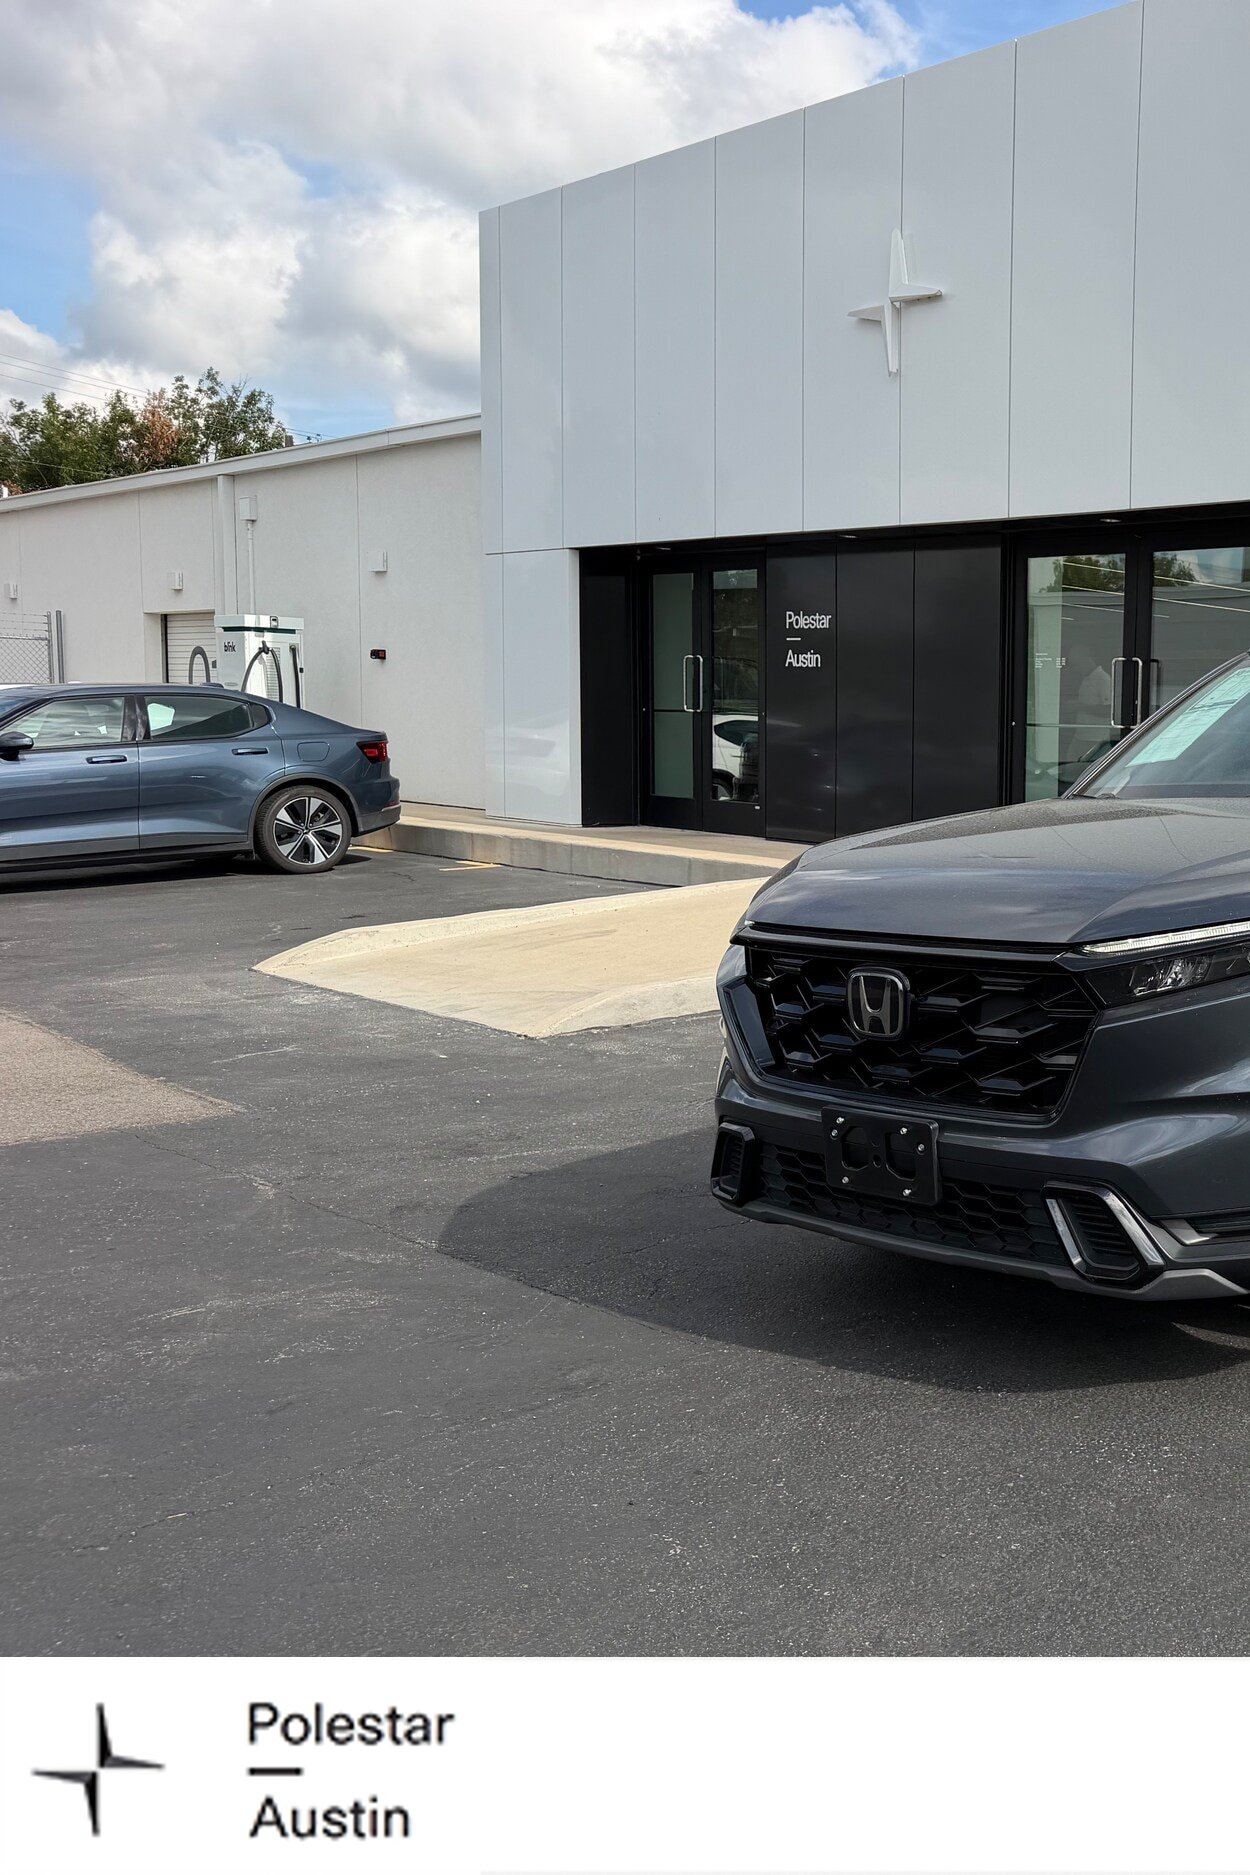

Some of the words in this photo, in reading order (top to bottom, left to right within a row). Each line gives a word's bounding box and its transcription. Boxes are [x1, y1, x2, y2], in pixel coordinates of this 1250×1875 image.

[785, 610, 832, 629] Polestar
[223, 641, 237, 653] blink
[785, 649, 821, 667] Austin
